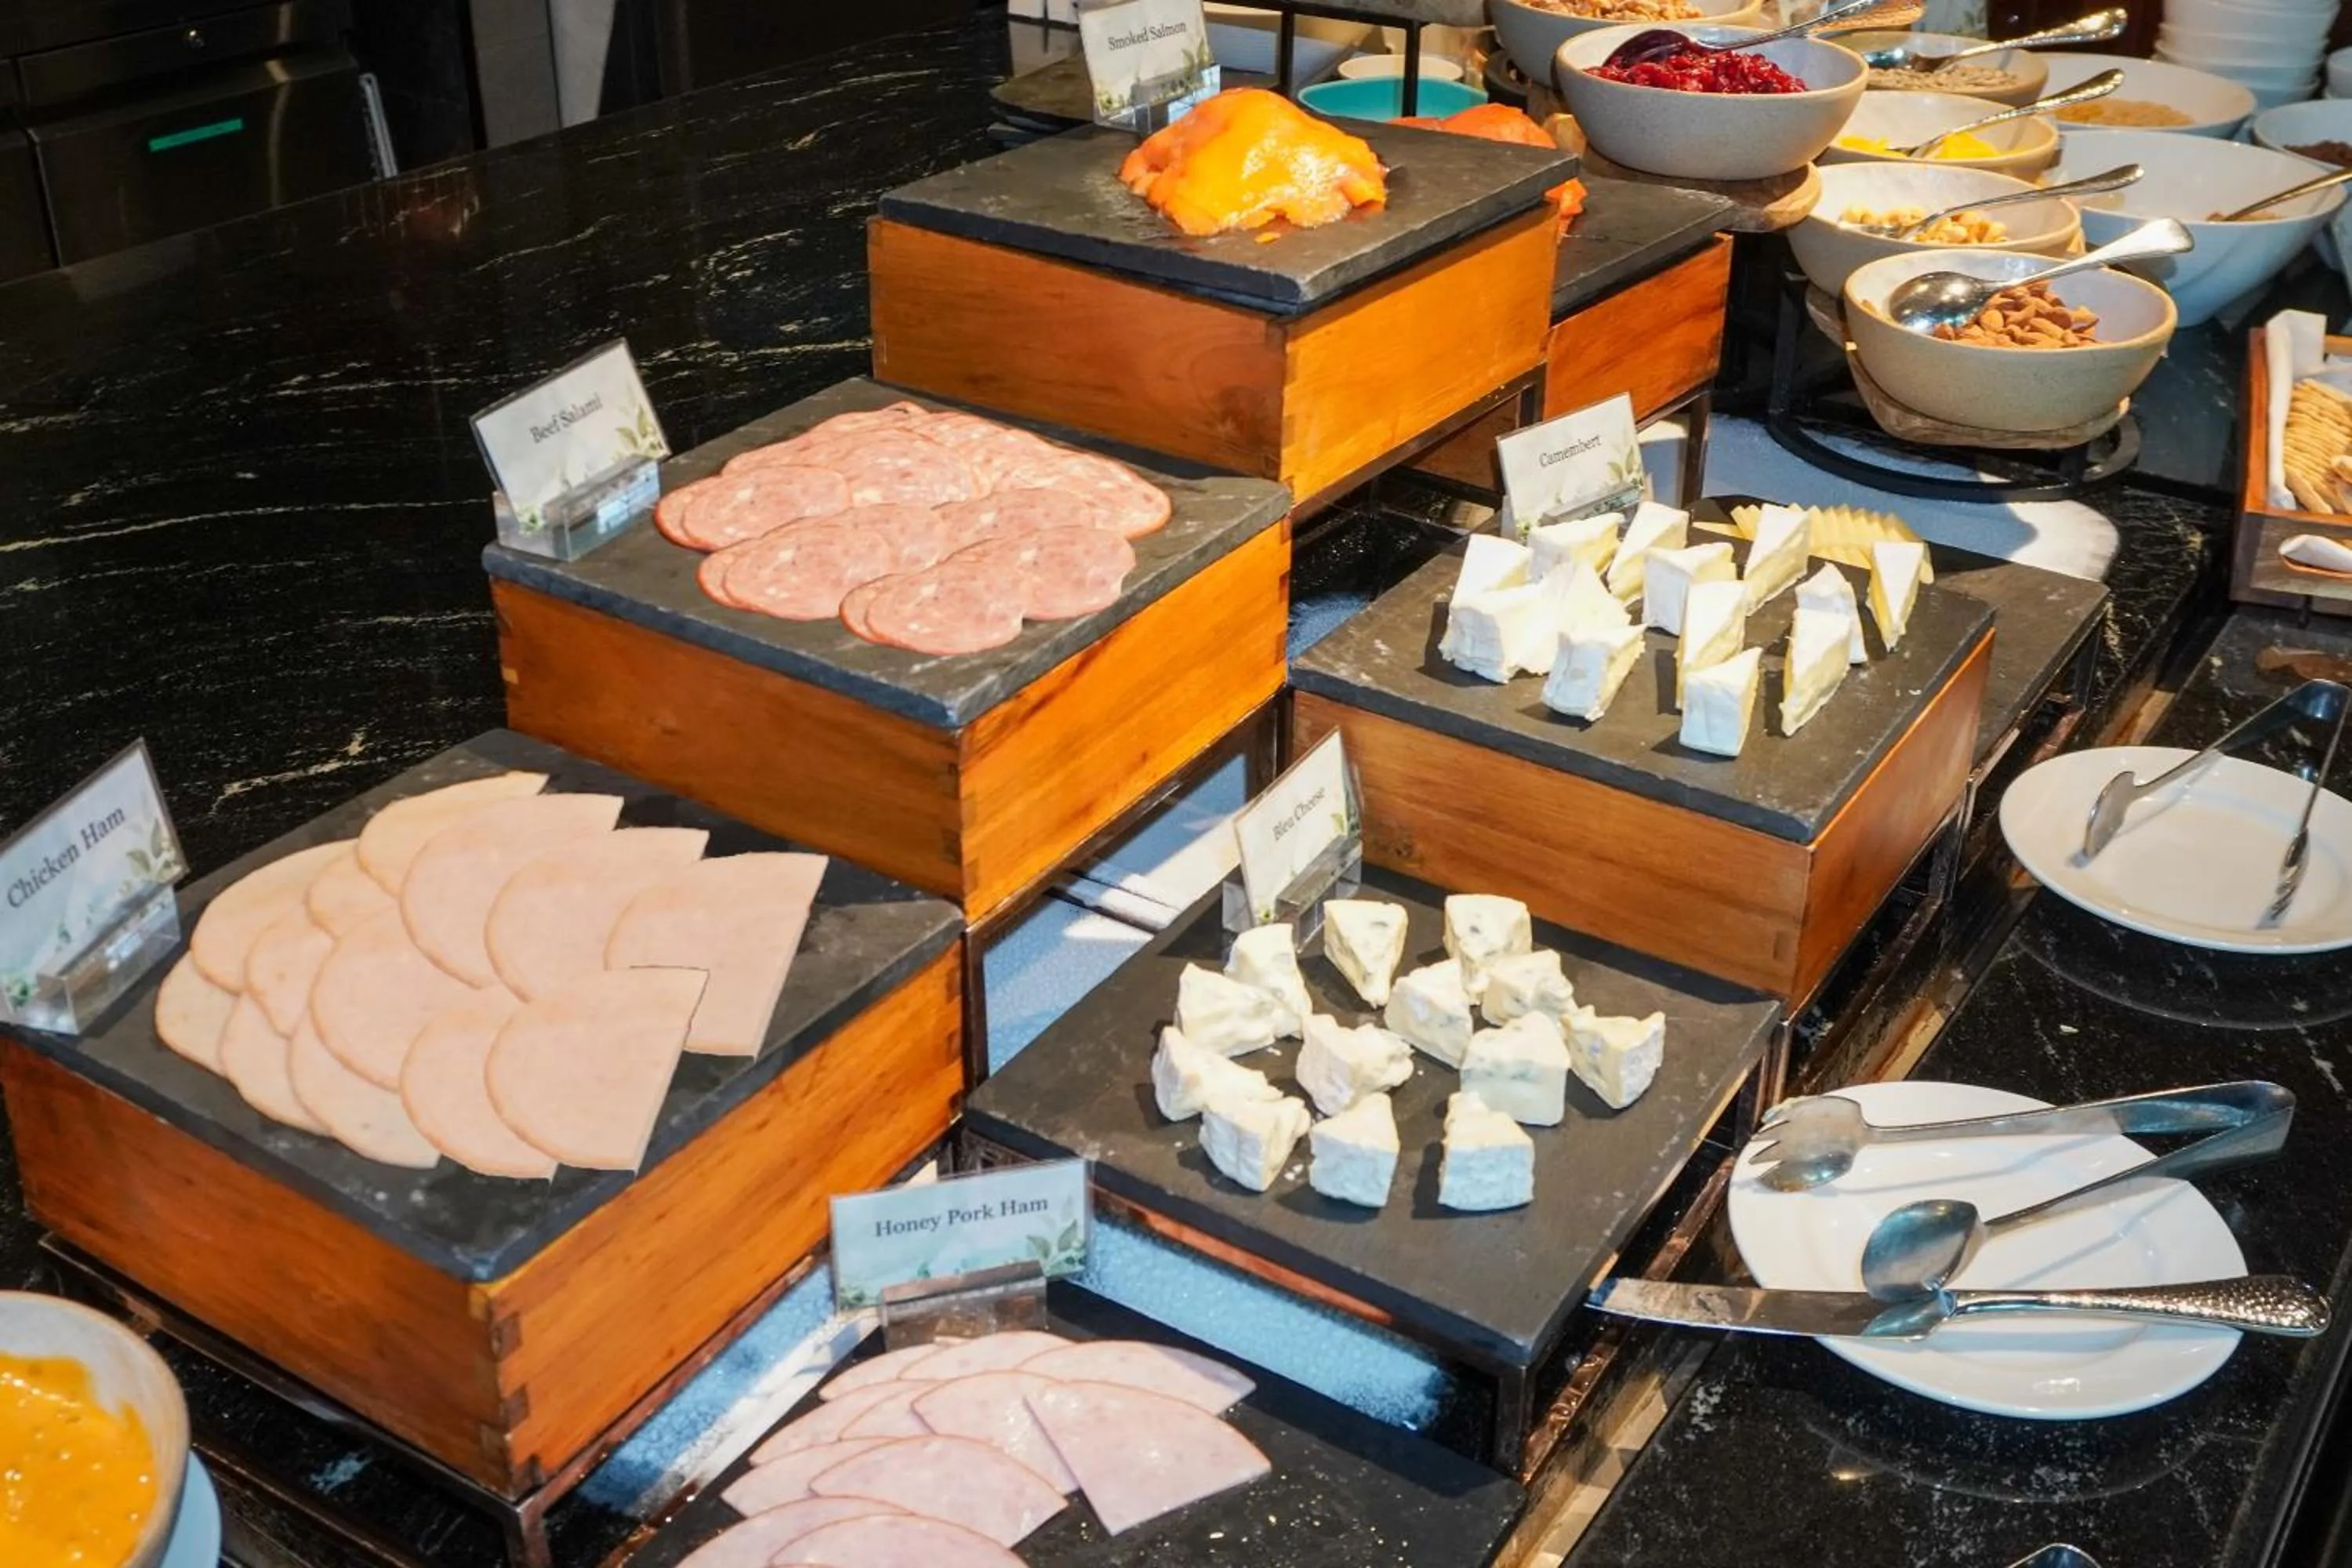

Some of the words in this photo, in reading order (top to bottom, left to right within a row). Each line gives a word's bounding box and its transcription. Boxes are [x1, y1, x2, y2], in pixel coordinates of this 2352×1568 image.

[1108, 27, 1149, 51] Smoked
[1149, 22, 1187, 40] Salmon
[529, 413, 561, 444] Beef
[559, 392, 603, 427] Salami
[1539, 434, 1602, 468] Camembert
[6, 842, 81, 909] Chicken
[80, 807, 125, 850] Ham
[875, 1213, 942, 1237] Honey
[947, 1205, 996, 1226] Pork
[1001, 1197, 1048, 1216] Ham
